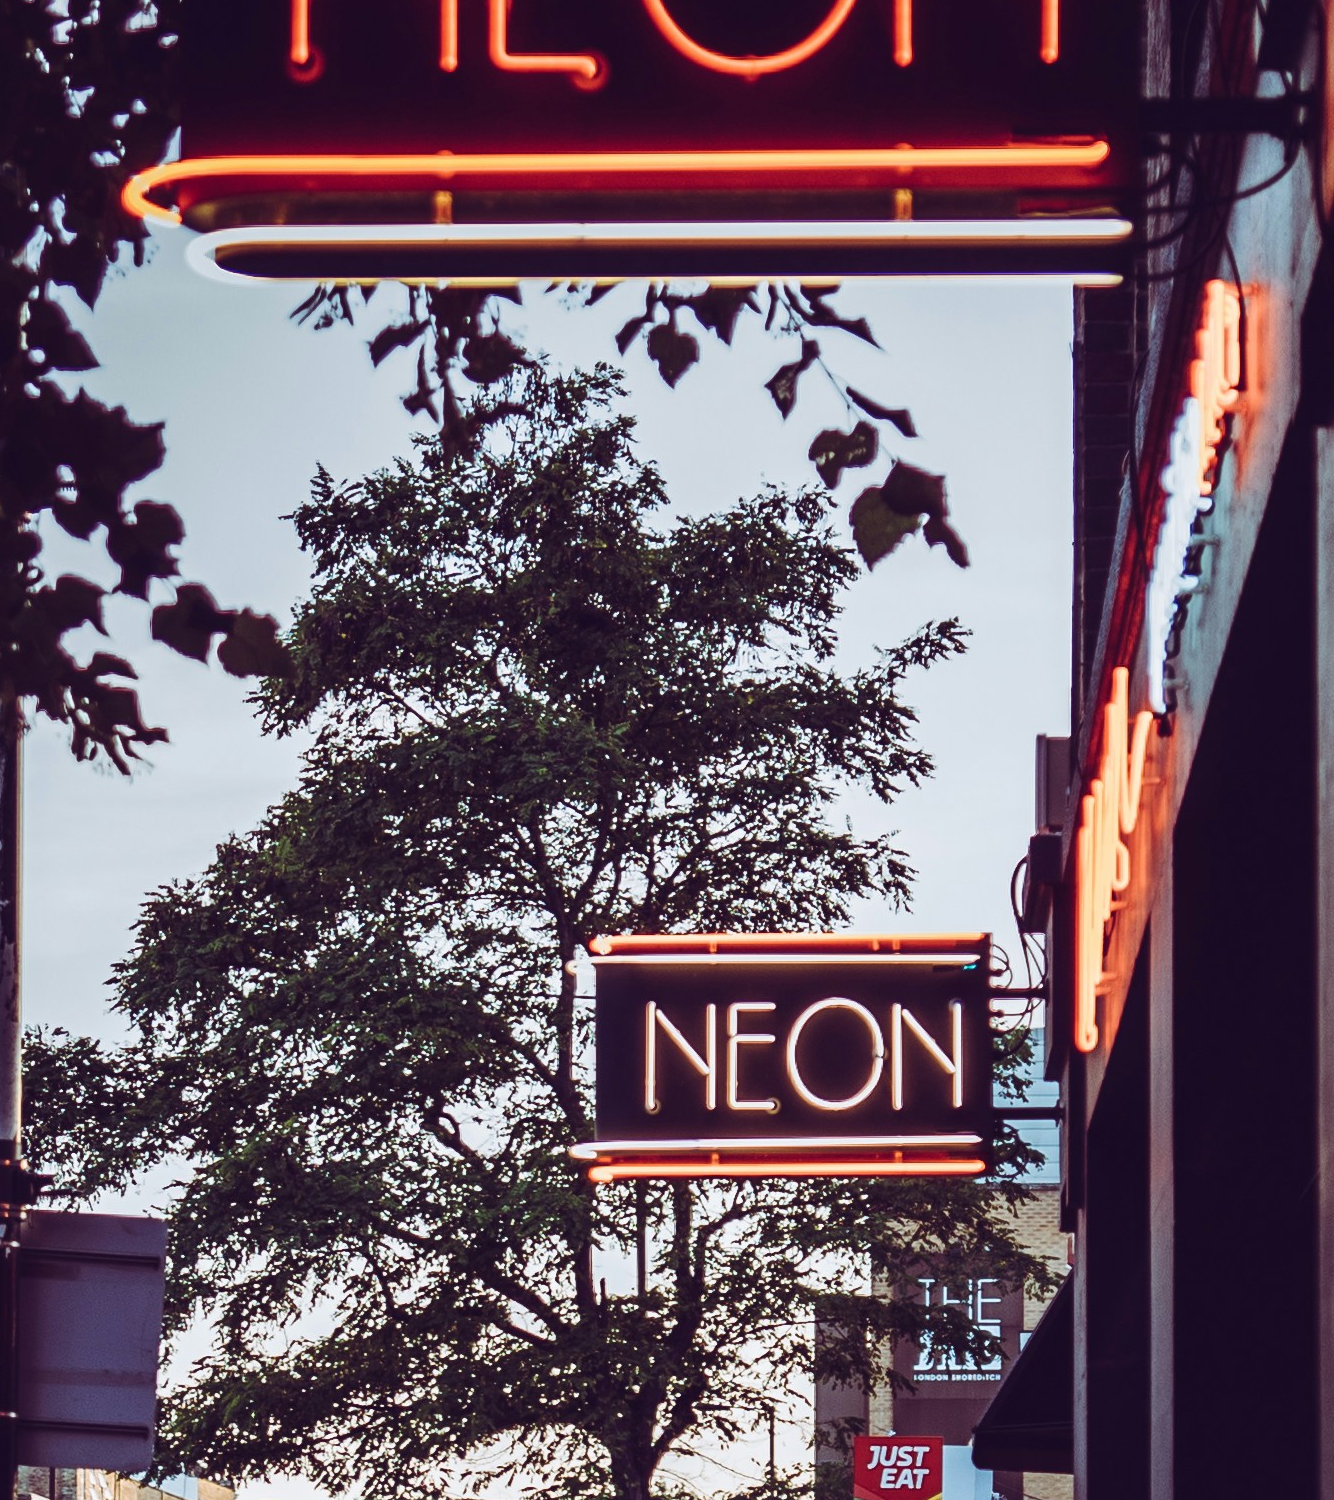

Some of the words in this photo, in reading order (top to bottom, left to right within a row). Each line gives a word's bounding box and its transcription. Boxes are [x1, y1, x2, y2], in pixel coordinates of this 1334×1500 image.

[644, 995, 964, 1114] NEON
[867, 1445, 930, 1470] JUST
[880, 1468, 930, 1489] EAT
